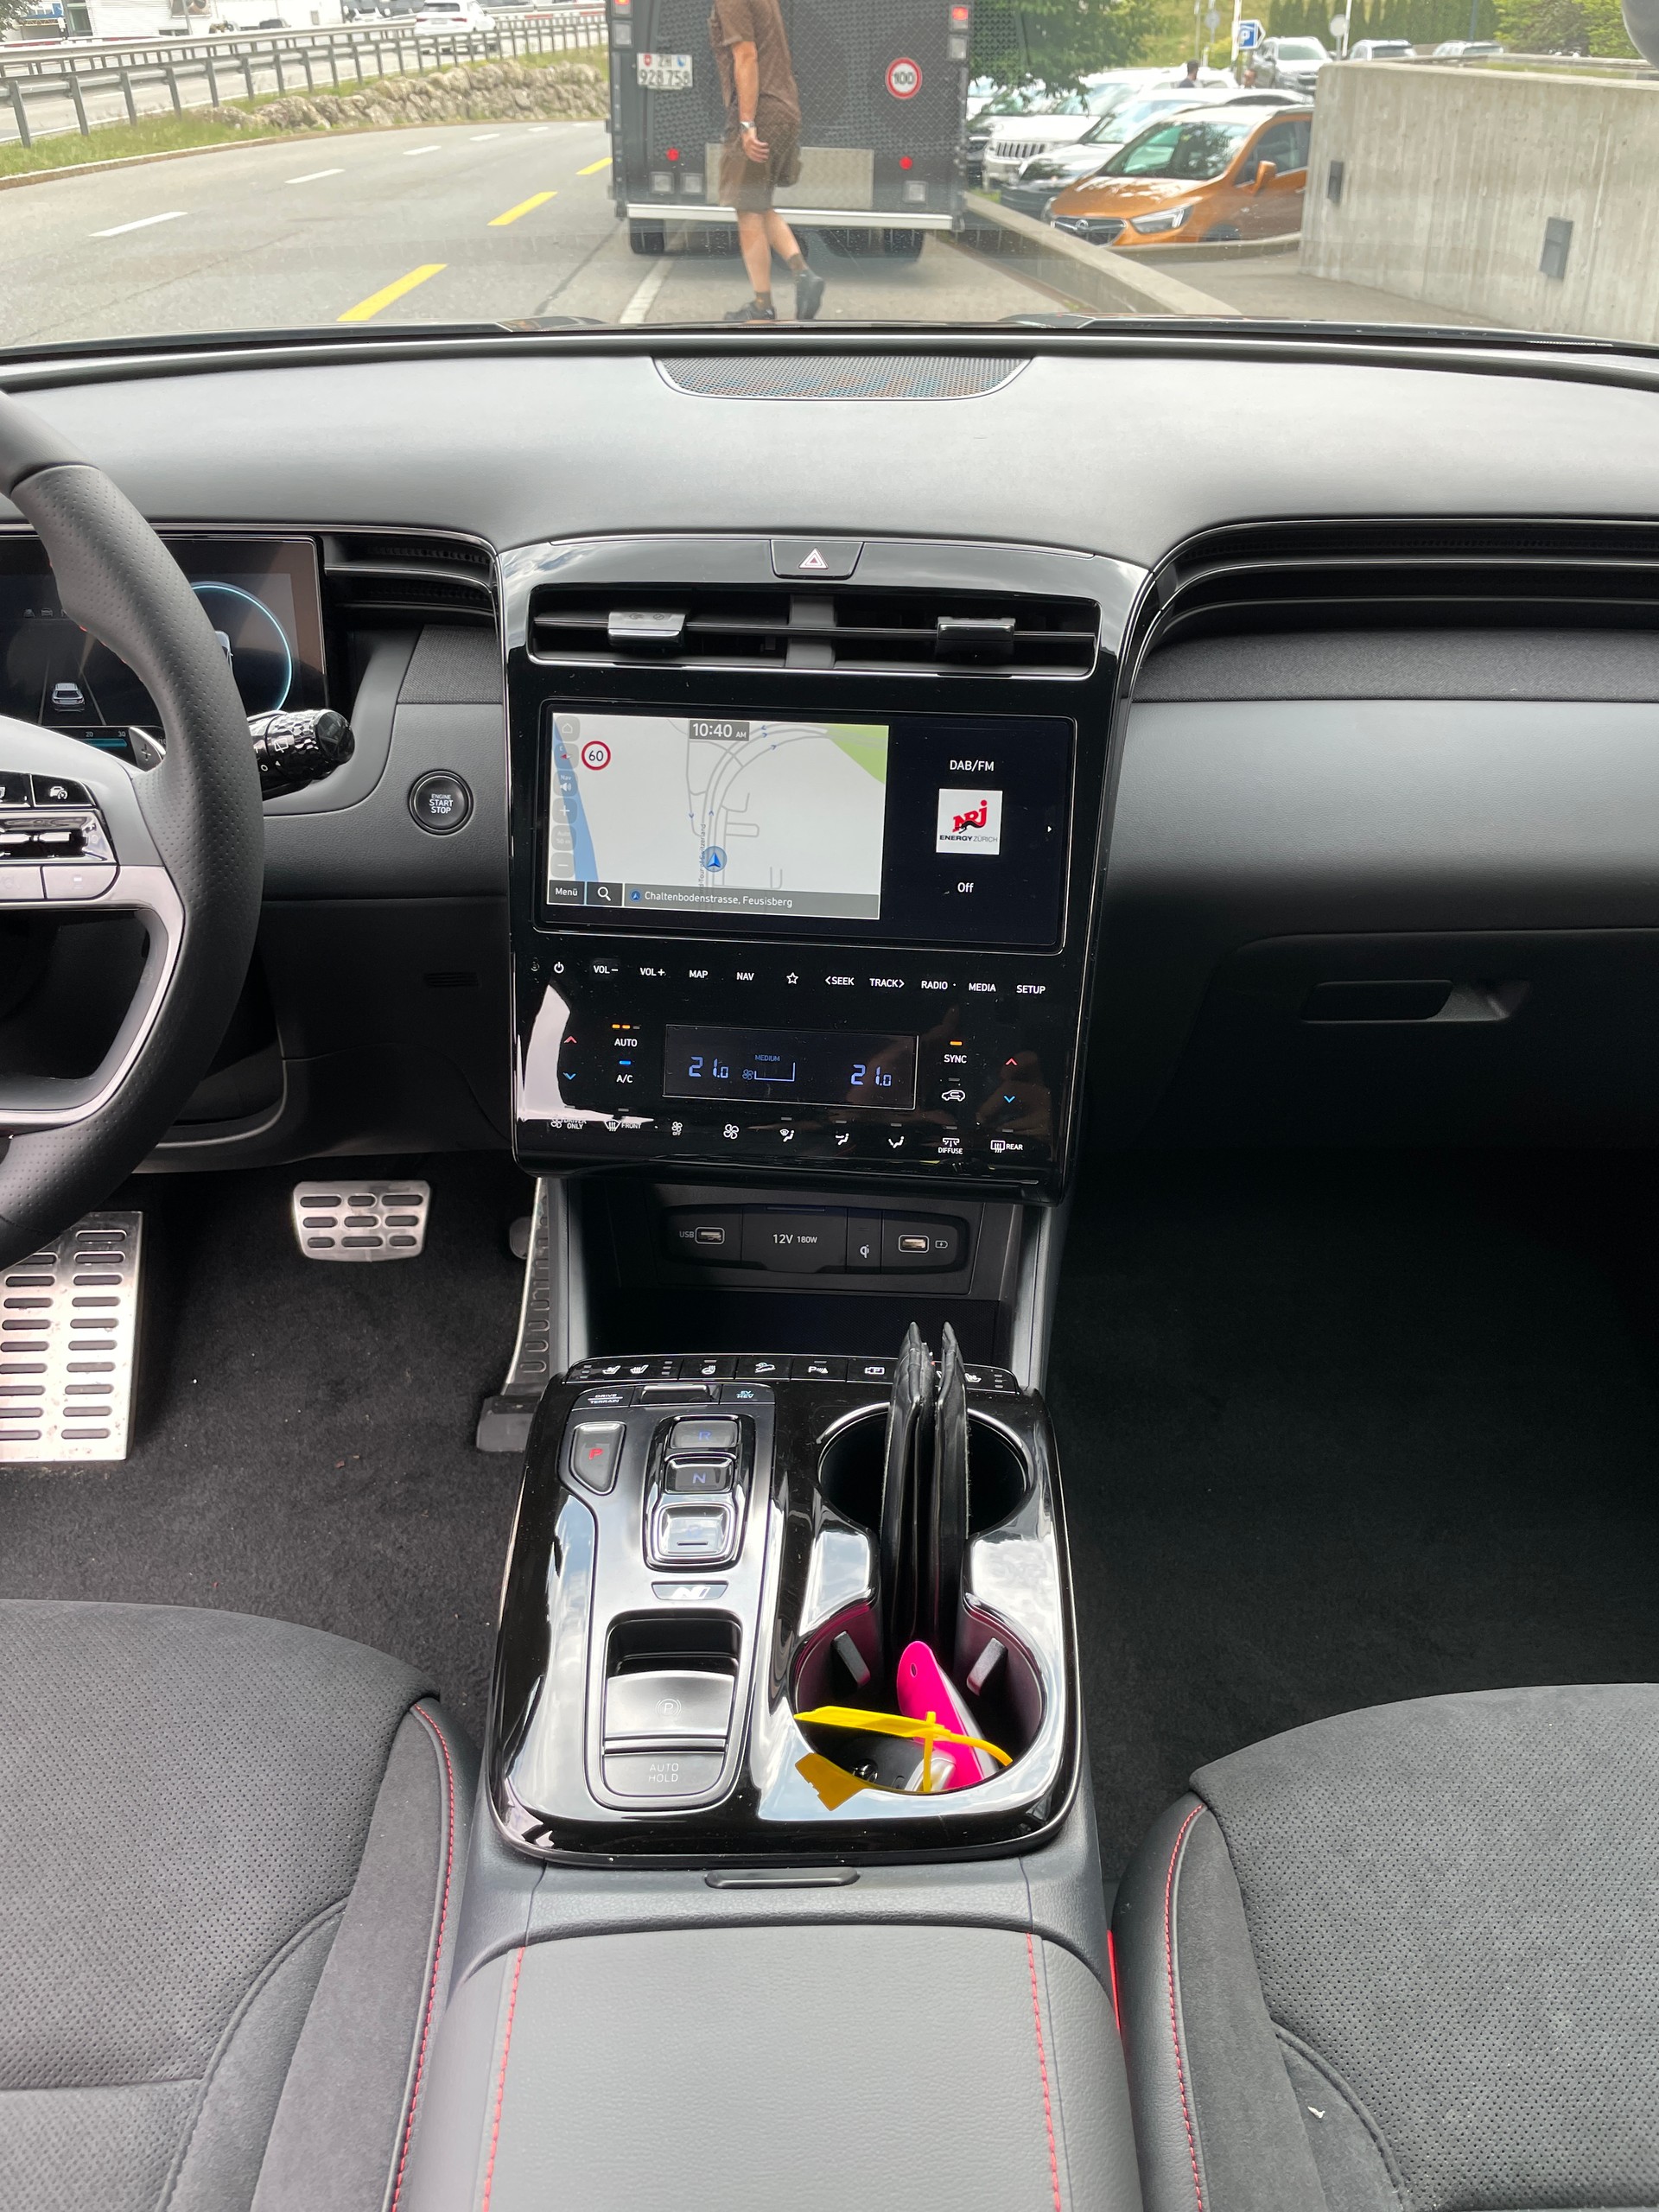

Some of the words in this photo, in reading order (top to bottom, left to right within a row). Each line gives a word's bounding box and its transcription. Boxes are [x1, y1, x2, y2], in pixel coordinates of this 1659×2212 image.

[893, 71, 915, 85] 100
[692, 722, 733, 738] 10:40
[588, 750, 604, 761] 60
[949, 760, 995, 772] DAB/FM
[429, 798, 454, 807] START
[555, 887, 578, 896] Menü
[957, 882, 974, 893] Off
[645, 891, 741, 905] Chaltenbodenstrasse,
[742, 896, 793, 908] Feusisberg
[689, 969, 709, 979] MAP
[736, 972, 754, 982] NAV
[921, 980, 949, 990] RADIO
[969, 982, 996, 993] MEDIA
[1016, 984, 1046, 995] SETUP
[614, 1038, 638, 1047] AUTO
[944, 1054, 968, 1064] SYNC
[616, 1073, 633, 1084] A/C
[772, 1233, 794, 1244] 12V
[698, 1430, 712, 1440] R
[588, 1448, 603, 1459] P
[692, 1472, 706, 1484] N
[649, 1763, 679, 1772] AUTO
[648, 1773, 678, 1783] HOLD
